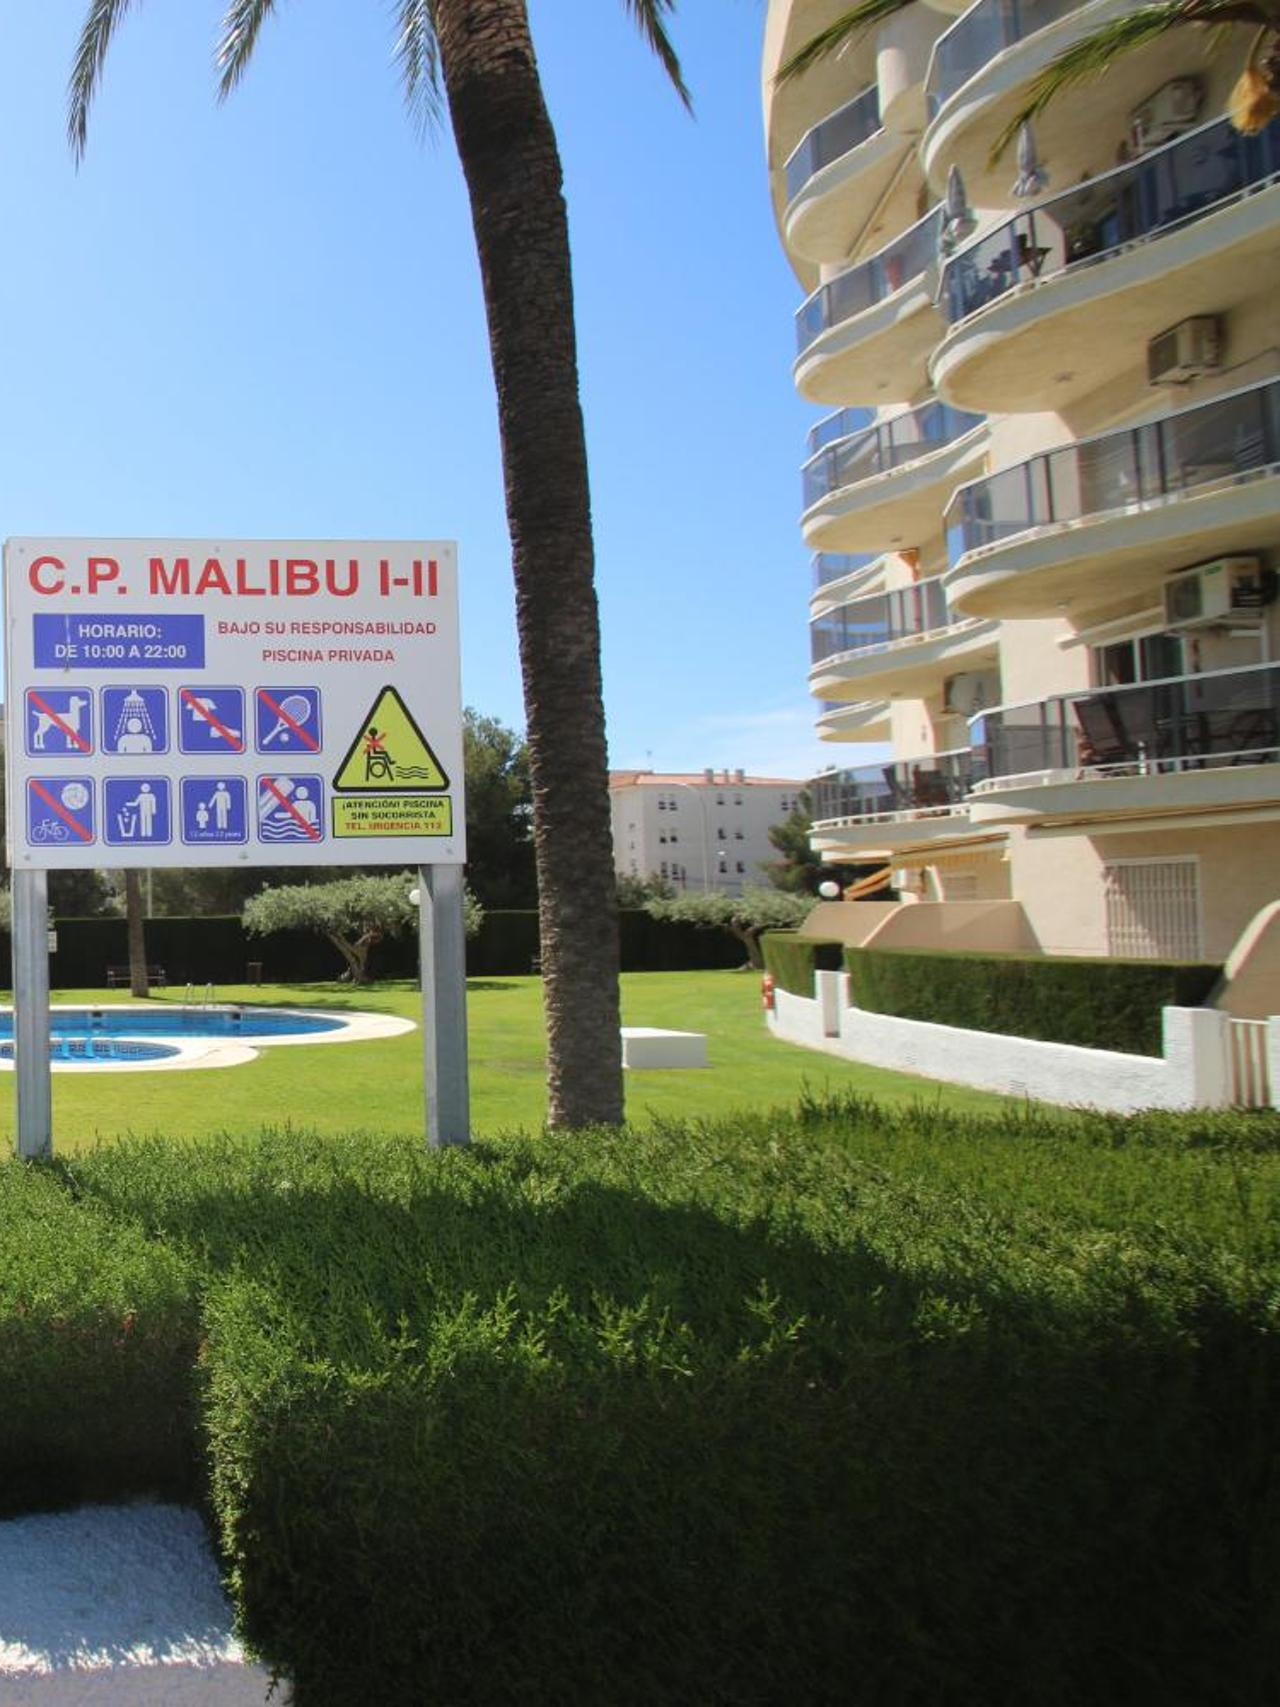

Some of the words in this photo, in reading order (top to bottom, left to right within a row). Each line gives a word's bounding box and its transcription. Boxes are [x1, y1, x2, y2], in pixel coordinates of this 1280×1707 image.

[28, 556, 127, 595] C.P.
[149, 558, 359, 597] MALIBU
[379, 560, 438, 596] I-II
[79, 624, 162, 639] HORARIO:
[218, 621, 260, 635] BAJO
[265, 621, 286, 635] SU
[291, 622, 436, 635] RESPONSABILIDAD
[55, 645, 78, 659] DE
[83, 645, 125, 659] 10:00
[129, 645, 141, 659] A
[144, 645, 187, 659] 22:00
[262, 649, 324, 662] PISCINA
[328, 649, 396, 662] PRIVADA
[403, 800, 444, 809] PISCINA
[351, 811, 369, 820] SIN
[371, 810, 436, 820] SOCORRISTA
[369, 822, 420, 830] URGENCIA
